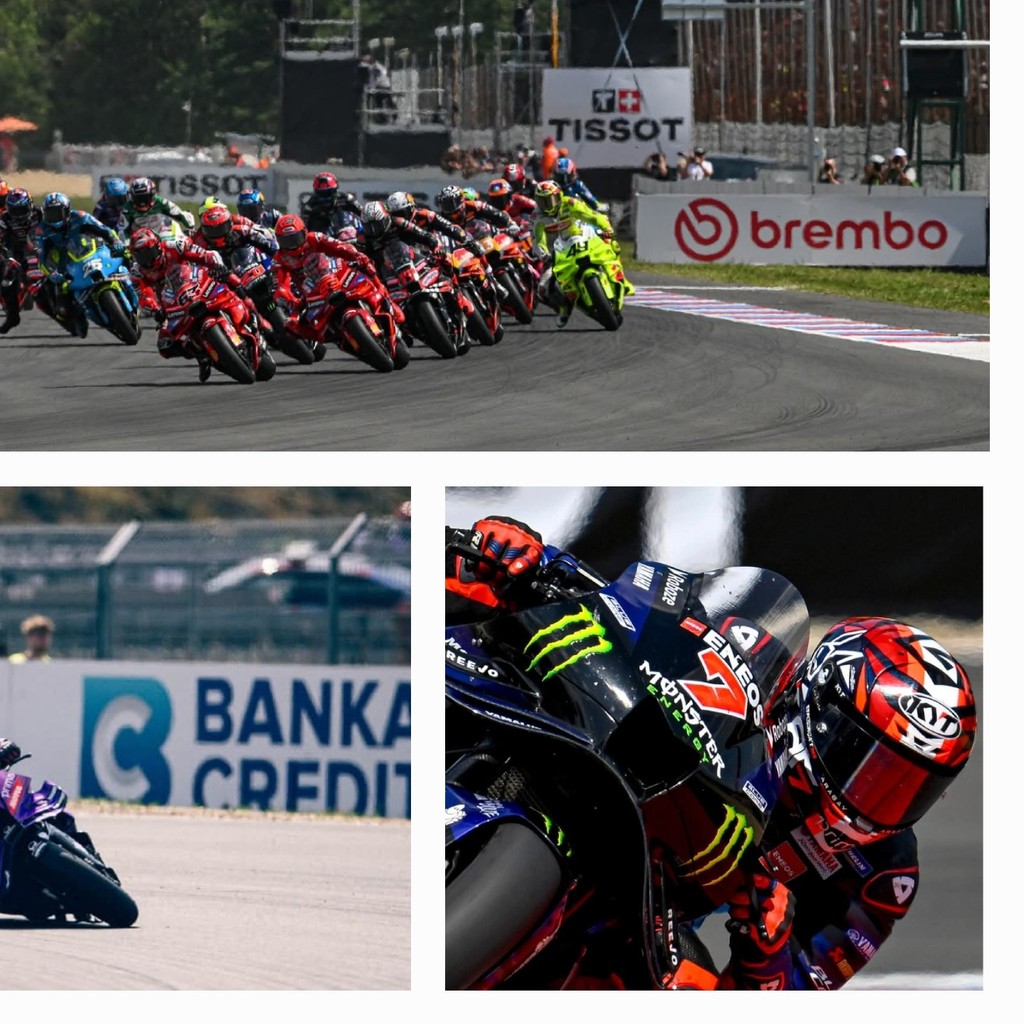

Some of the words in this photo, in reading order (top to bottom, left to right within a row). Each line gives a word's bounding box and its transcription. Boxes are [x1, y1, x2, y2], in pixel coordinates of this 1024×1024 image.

[548, 116, 685, 144] TISSOT
[750, 209, 951, 251] brembo
[632, 561, 661, 592] YAMAHA
[667, 571, 694, 606] Roboze
[446, 649, 499, 678] REEJO
[676, 647, 748, 721] 7
[702, 629, 764, 727] ENEOS
[195, 678, 412, 748] BANKA
[638, 659, 726, 779] MONSTER
[646, 683, 710, 764] ENERGY
[904, 695, 957, 734] KYT
[769, 849, 796, 877] ENEOS
[666, 907, 679, 966] REEJO
